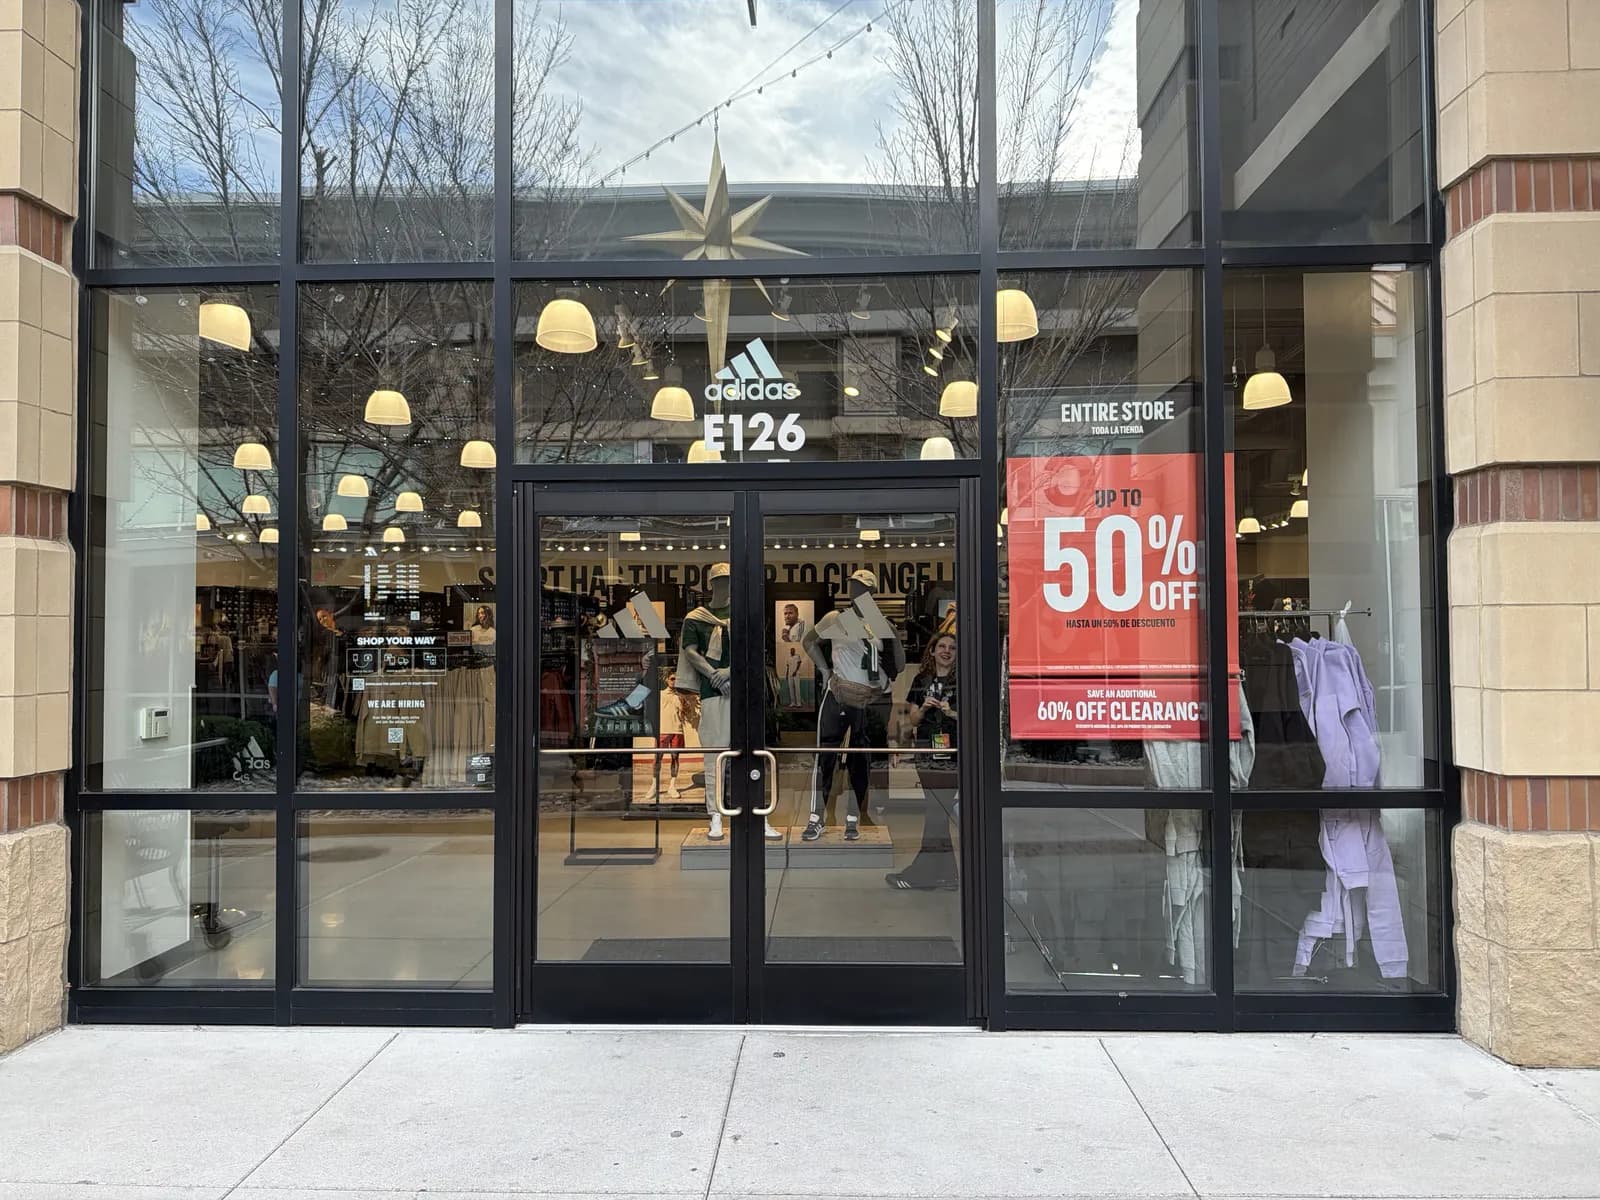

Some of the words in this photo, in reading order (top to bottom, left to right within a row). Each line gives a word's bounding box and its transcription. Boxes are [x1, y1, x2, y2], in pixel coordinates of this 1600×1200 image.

[704, 378, 799, 401] adidas
[1061, 402, 1118, 422] ENTIRE
[1121, 400, 1175, 420] STORE
[703, 411, 806, 452] E126
[1091, 426, 1109, 435] TODA
[1110, 426, 1120, 435] LA
[1120, 425, 1144, 434] TIENDA
[1095, 489, 1117, 508] UP
[1120, 488, 1142, 507] TO
[1042, 513, 1197, 613] 50%
[1149, 580, 1197, 611] OFF
[1066, 619, 1090, 629] HASTA
[1091, 619, 1102, 628] UN
[1103, 619, 1119, 628] 50%
[1120, 618, 1130, 628] DE
[1131, 618, 1176, 628] DESCUENTO
[356, 636, 385, 646] SHOP
[385, 636, 413, 646] YOUR
[414, 636, 437, 645] WAY
[367, 699, 380, 709] WE
[380, 699, 396, 709] ARE
[398, 699, 425, 709] HIRING
[1087, 689, 1104, 699] SAVE
[1105, 689, 1115, 698] AN
[1116, 689, 1157, 698] ADDITIONAL
[1037, 701, 1073, 721] 60%
[1075, 701, 1107, 721] OFF
[1109, 701, 1200, 721] CLEARANC
